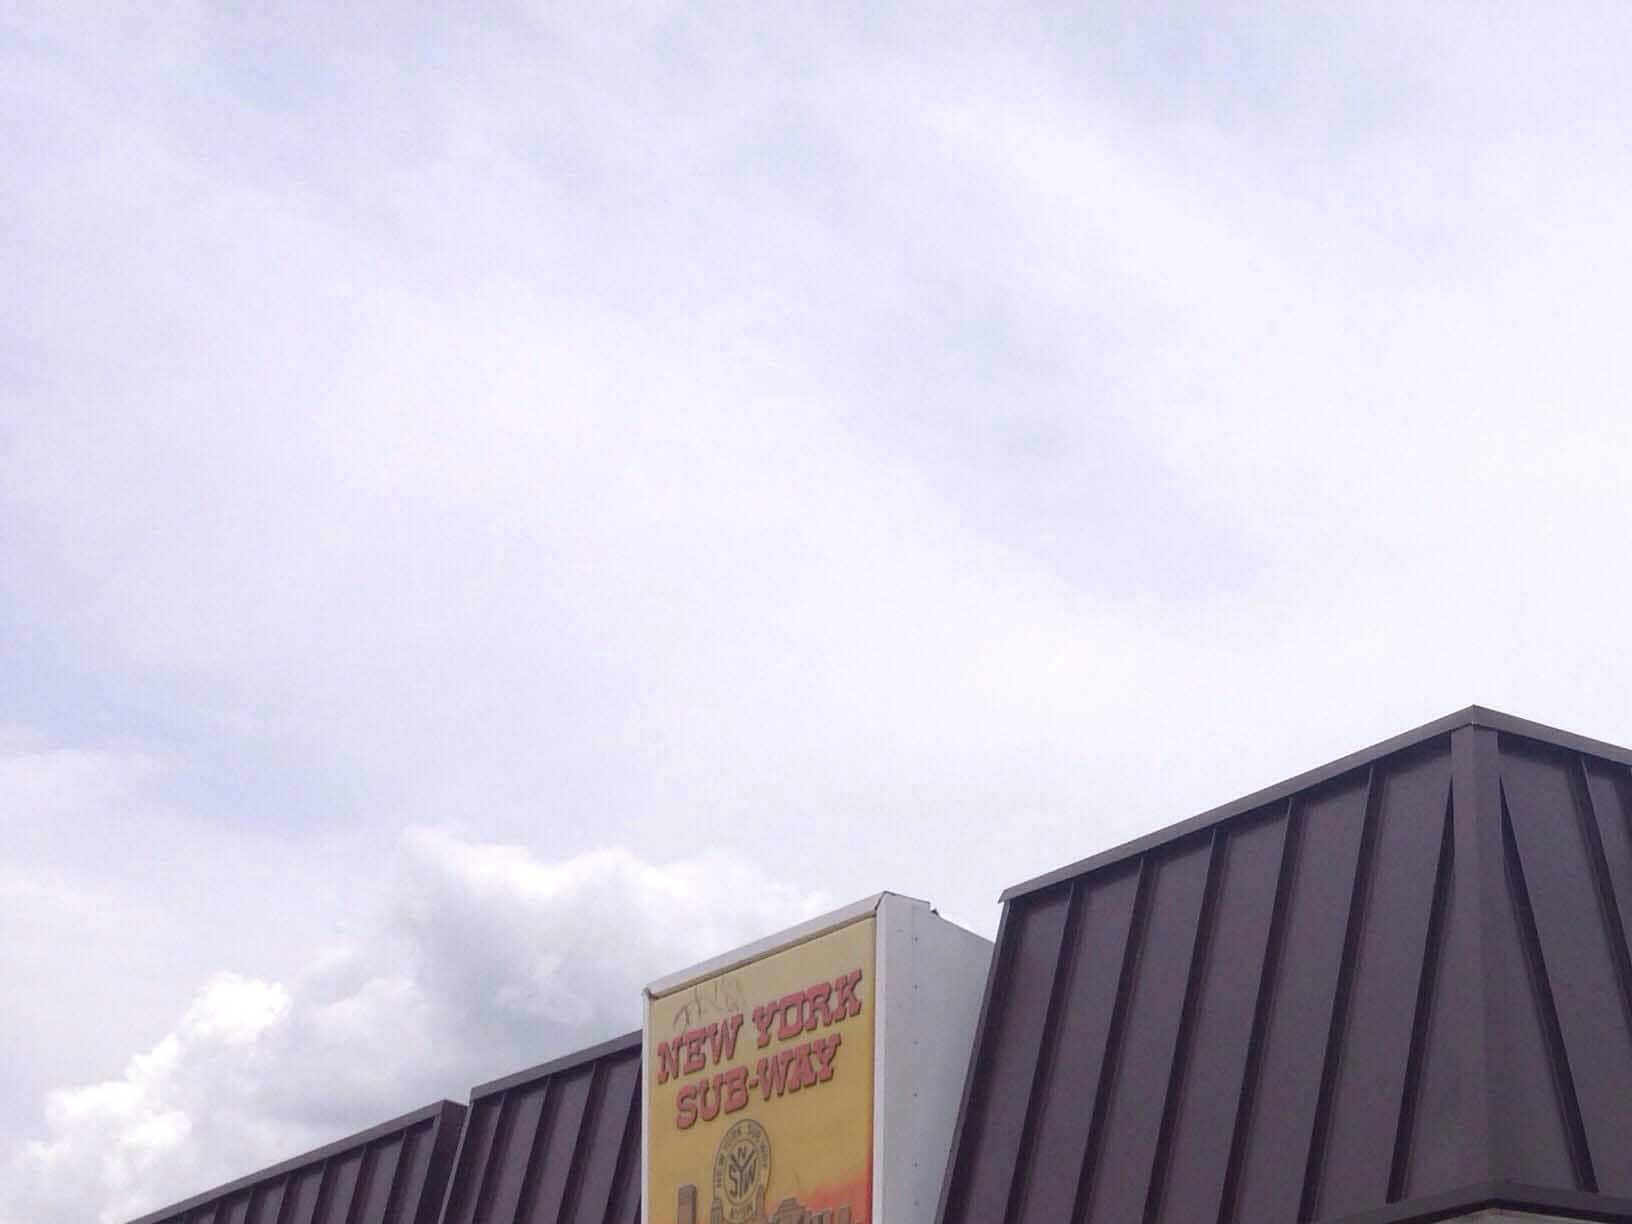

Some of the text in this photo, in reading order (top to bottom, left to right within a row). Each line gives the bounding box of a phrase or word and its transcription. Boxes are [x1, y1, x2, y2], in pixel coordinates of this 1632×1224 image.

[657, 968, 864, 1086] NEW YORK
[676, 1032, 842, 1130] SUB-WAY
